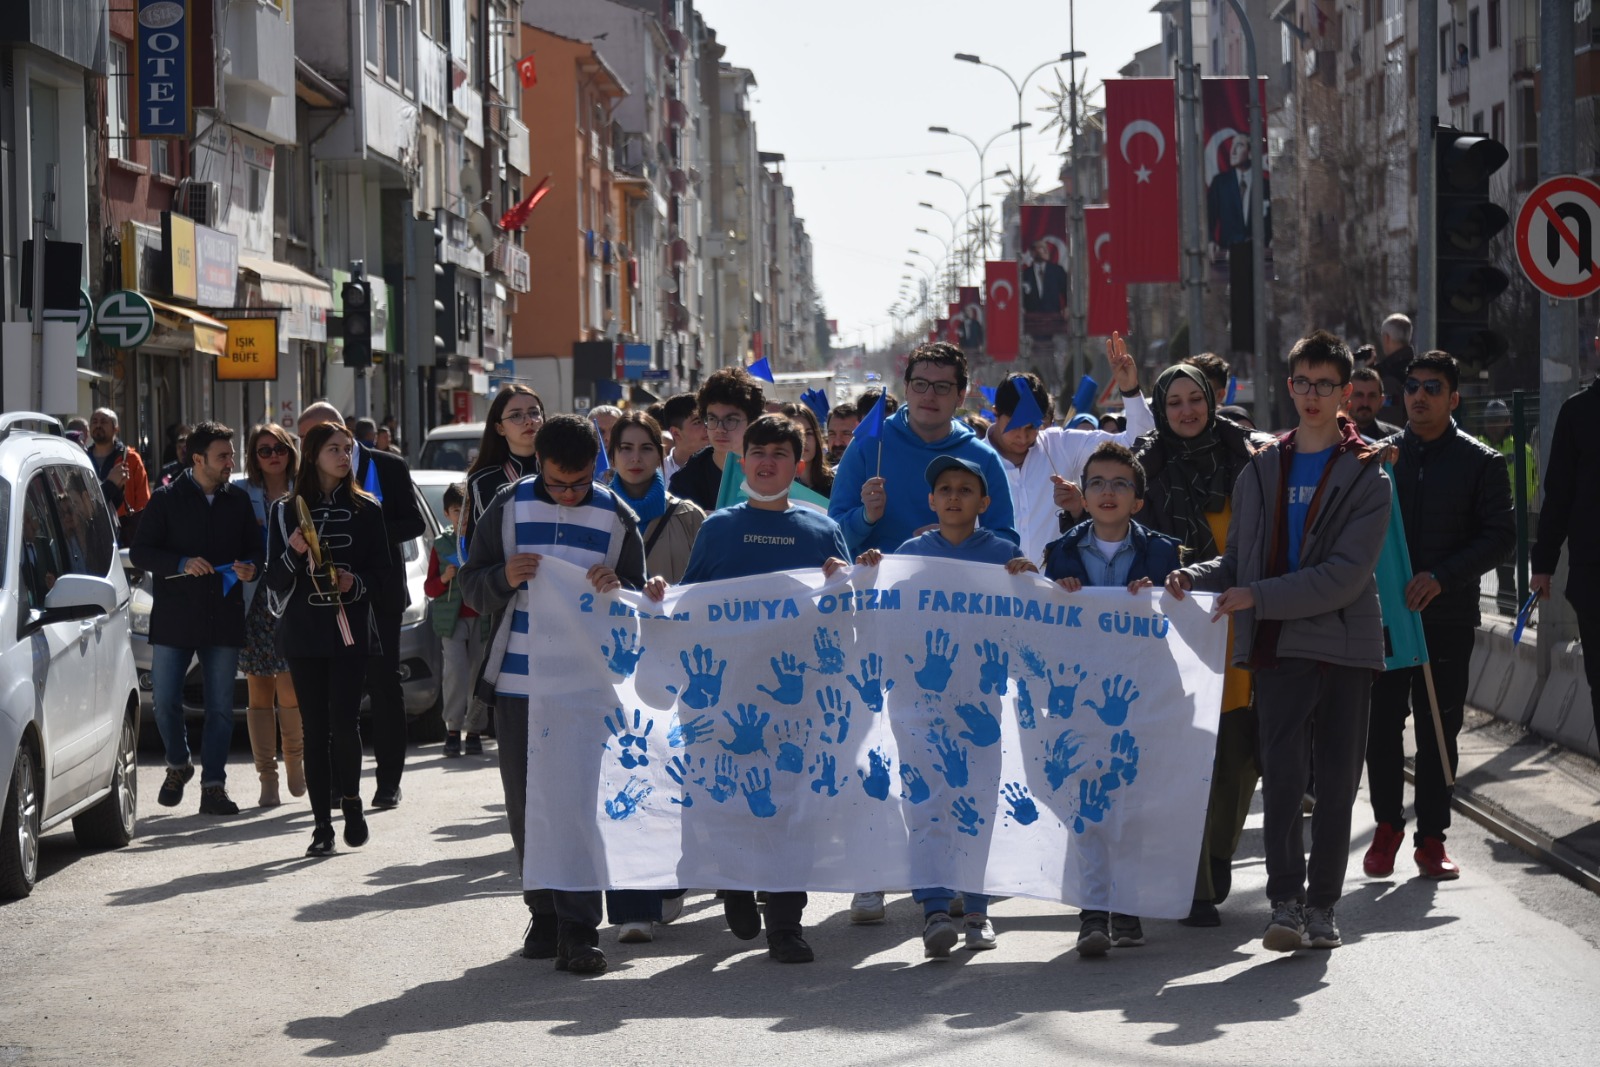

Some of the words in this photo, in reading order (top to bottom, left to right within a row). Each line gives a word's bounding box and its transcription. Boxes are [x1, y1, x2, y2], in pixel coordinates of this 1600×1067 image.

[147, 32, 180, 127] OTEL
[235, 337, 256, 350] IŞIK
[232, 350, 259, 363] BÜFE
[743, 534, 795, 546] EXPECTATION
[579, 592, 595, 613] 2
[708, 597, 800, 623] DÜNYA
[918, 589, 1083, 629] FARKINDALIK
[1098, 609, 1169, 640] GÜNÜ
